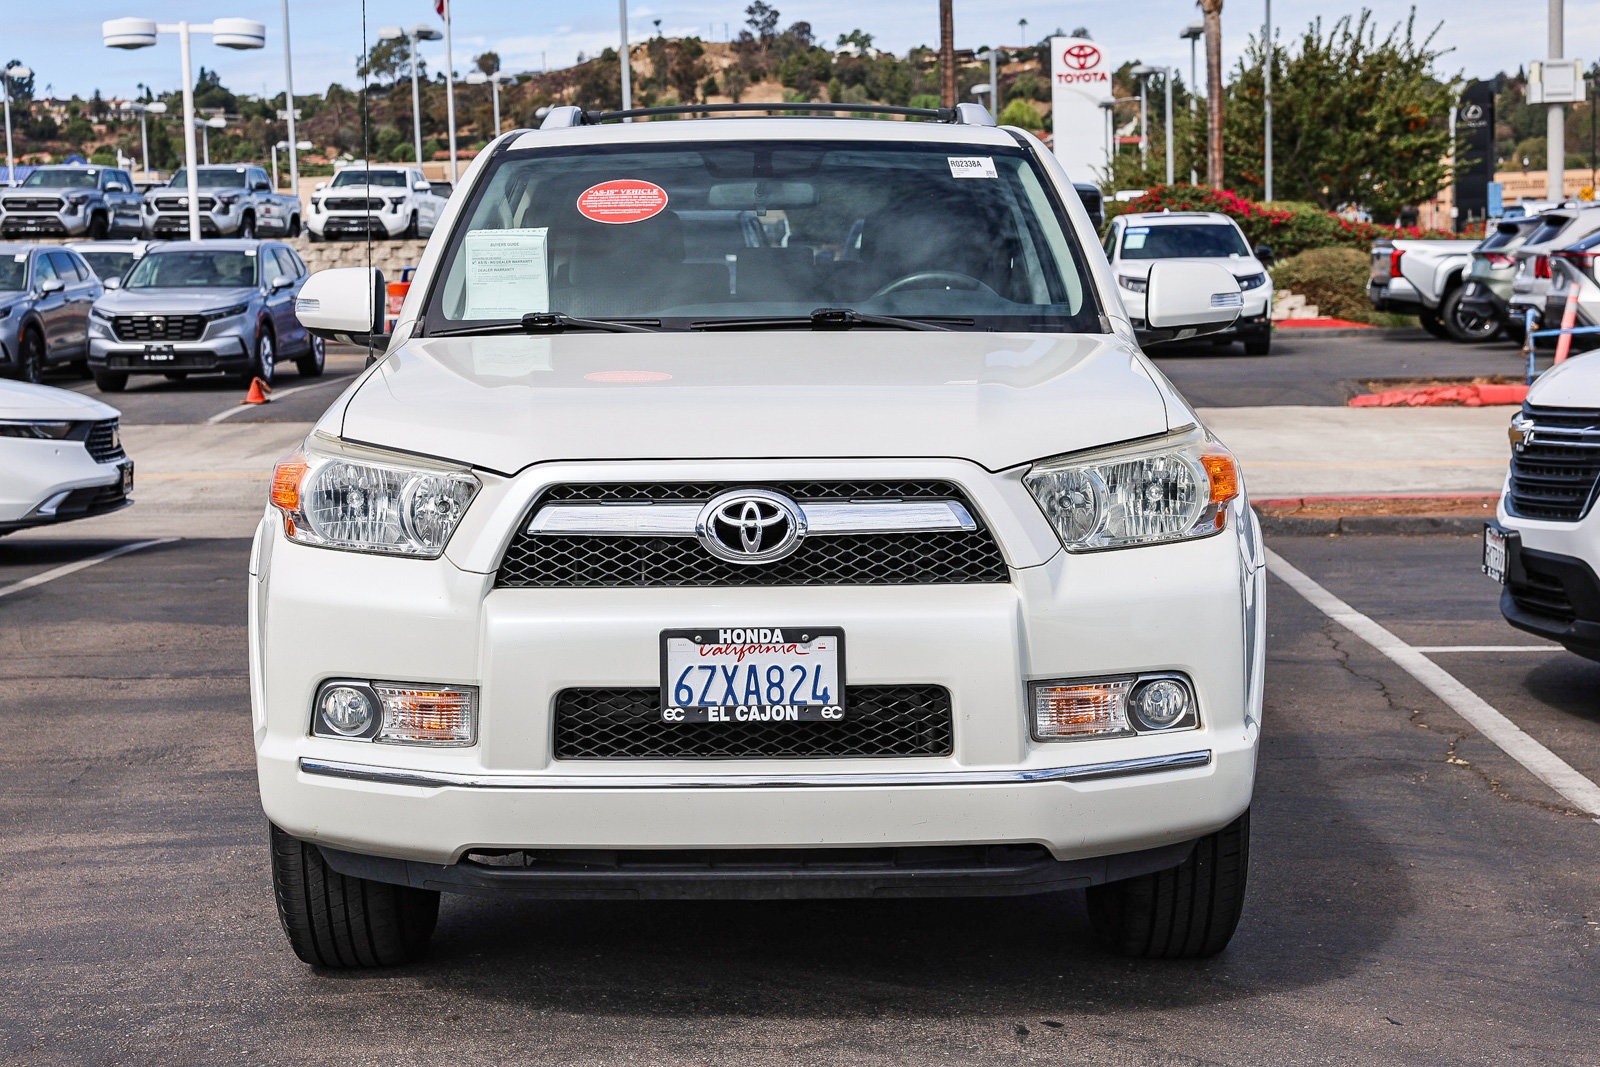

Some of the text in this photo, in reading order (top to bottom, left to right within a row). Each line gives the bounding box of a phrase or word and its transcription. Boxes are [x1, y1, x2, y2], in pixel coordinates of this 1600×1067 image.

[1057, 72, 1107, 83] TOYOTA
[719, 628, 784, 643] HONDA
[700, 642, 809, 662] California
[674, 664, 830, 706] 6ZXA824
[708, 705, 799, 721] EL CAJON
